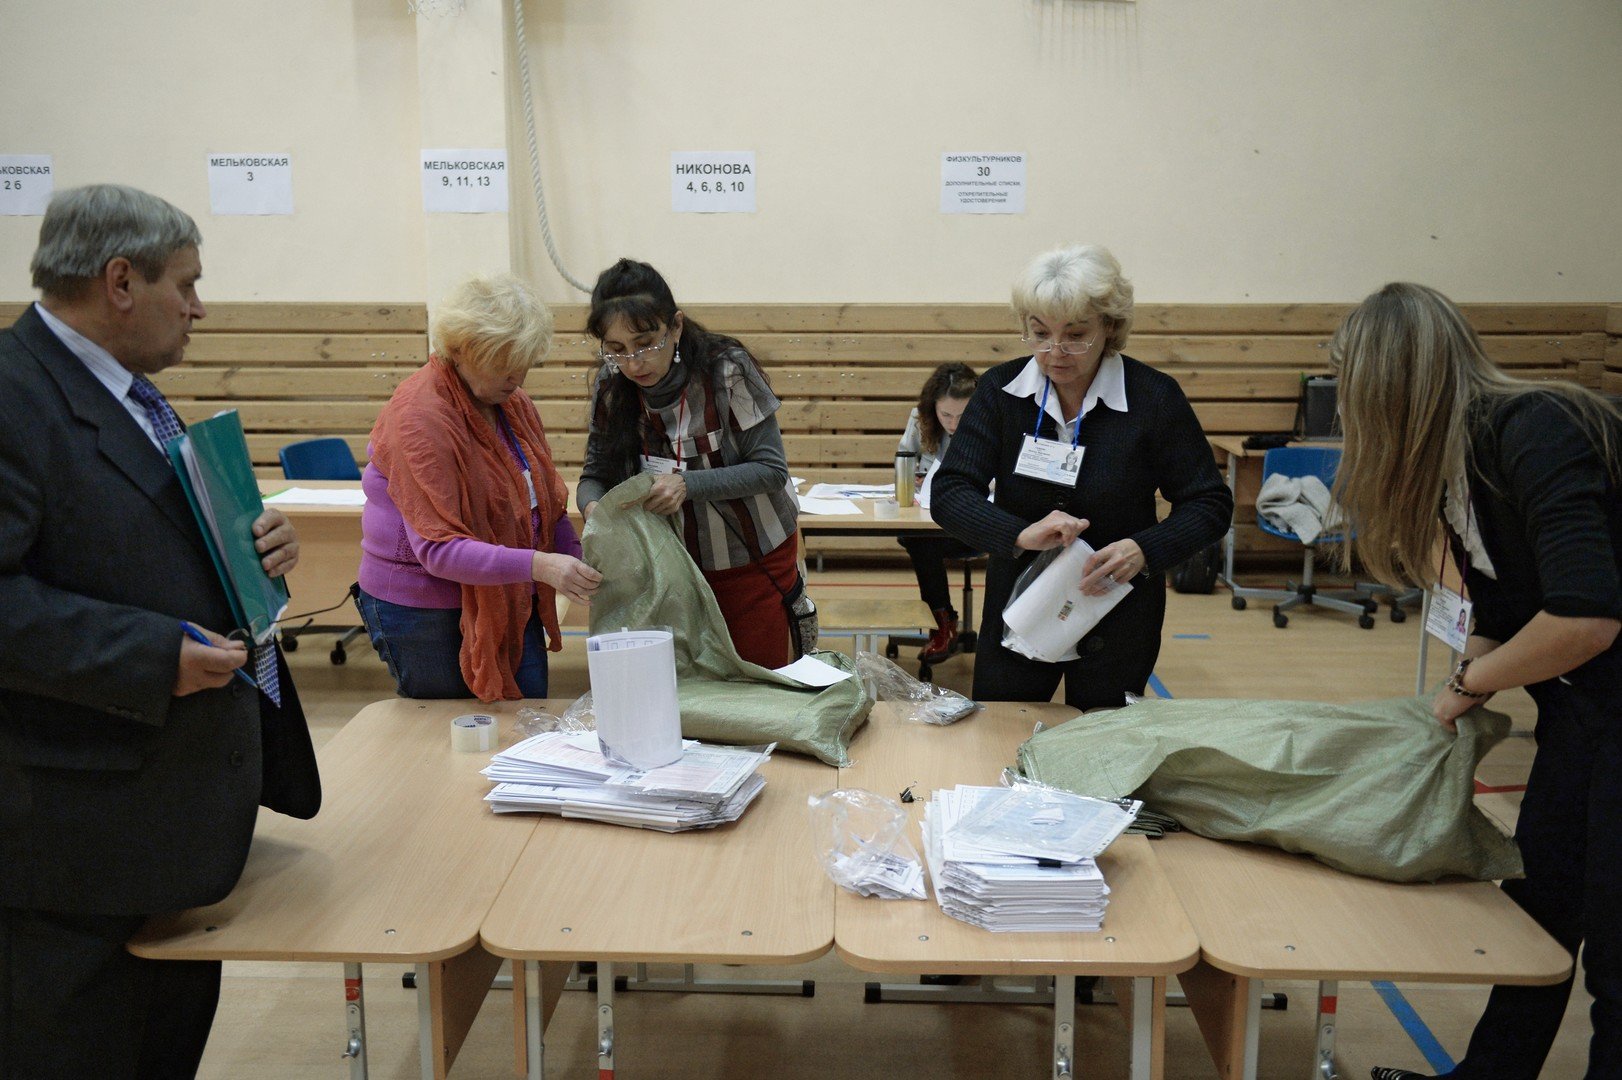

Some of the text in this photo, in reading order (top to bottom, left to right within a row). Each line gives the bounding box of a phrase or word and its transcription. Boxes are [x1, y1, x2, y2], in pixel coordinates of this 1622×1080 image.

[210, 158, 289, 167] МЕЛЬКОВСКАЯ
[946, 155, 1022, 163] ФИЗКУЛЬТУРНИКОВ
[0, 166, 51, 175] КОВСКАЯ
[424, 161, 505, 170] МЕЛЬКОВСКАЯ
[676, 163, 751, 175] НИКОНОВА
[247, 171, 254, 182] 3
[976, 166, 991, 177] 30
[442, 175, 490, 188] 9, 11, 13
[686, 181, 745, 193] 4, 6, 8, 10
